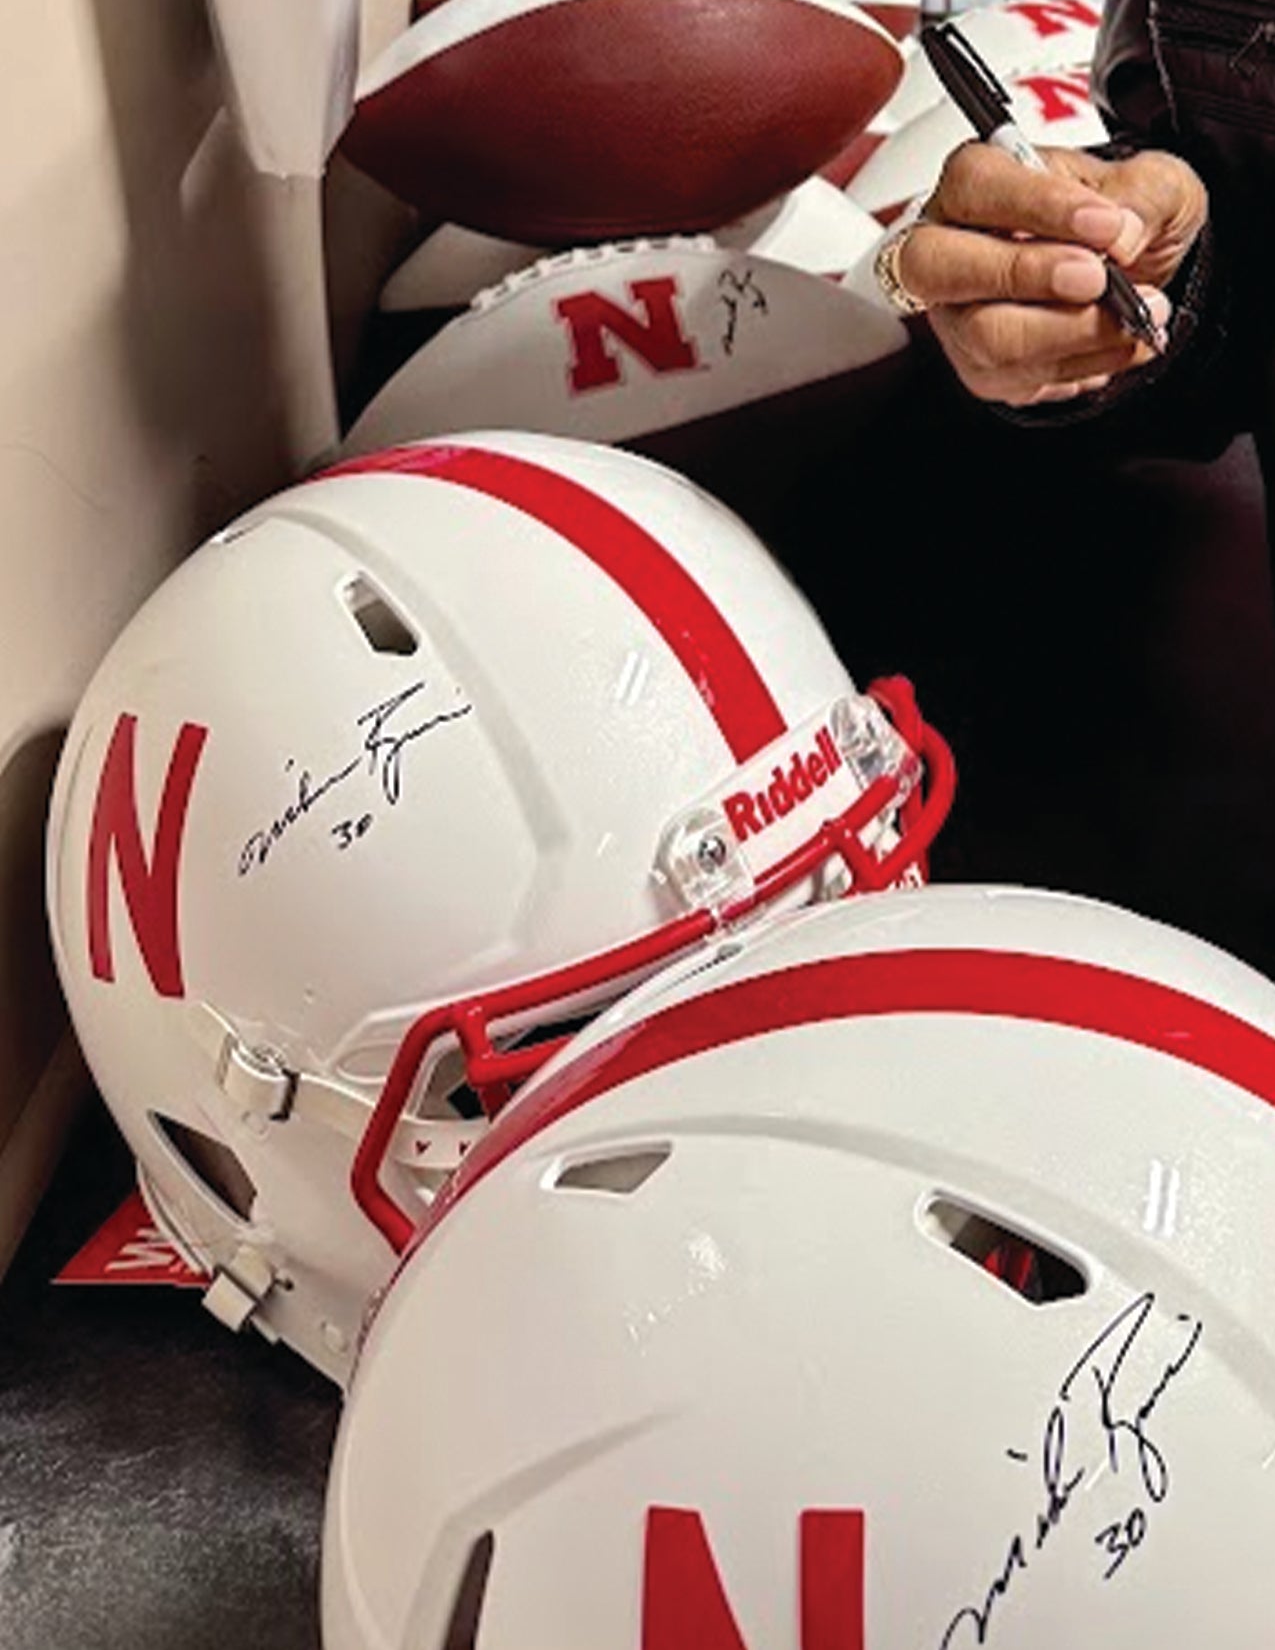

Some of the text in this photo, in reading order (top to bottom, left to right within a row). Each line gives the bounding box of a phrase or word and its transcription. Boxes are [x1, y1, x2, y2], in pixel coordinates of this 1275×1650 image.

[554, 276, 698, 395] N
[725, 730, 842, 840] Riddell
[89, 714, 208, 997] N
[1094, 1506, 1149, 1582] 30
